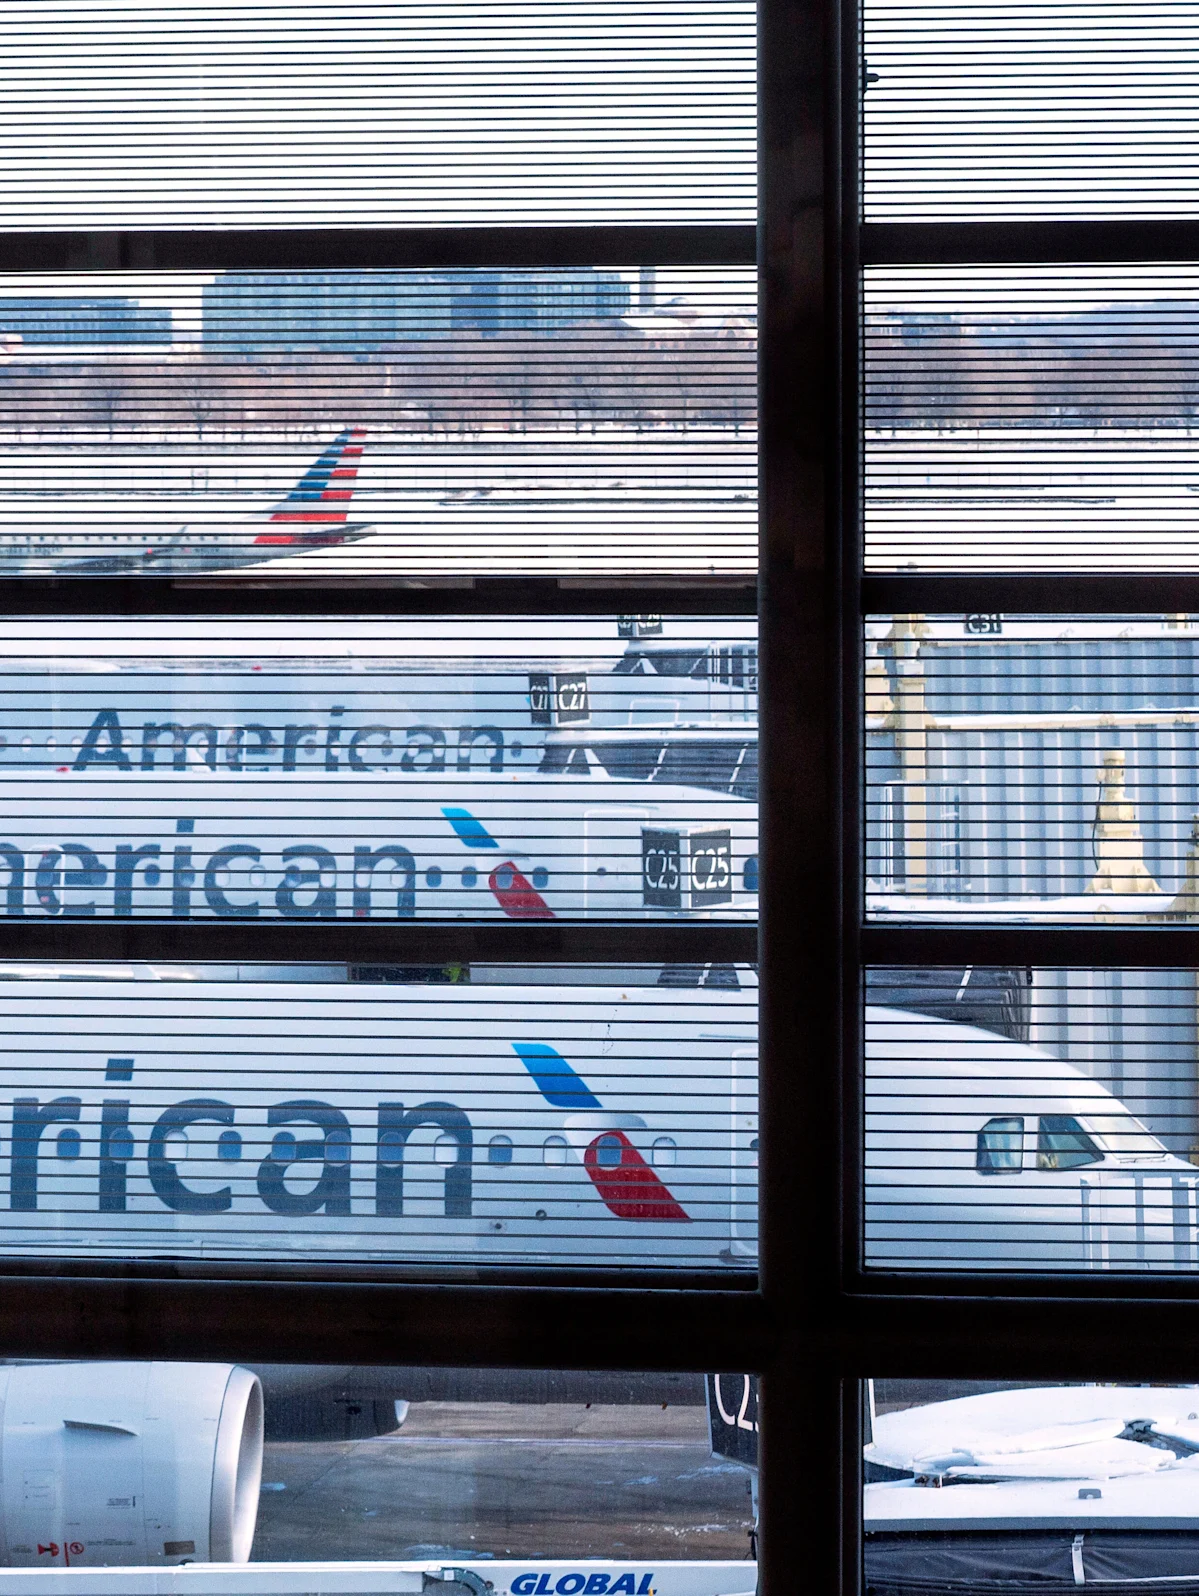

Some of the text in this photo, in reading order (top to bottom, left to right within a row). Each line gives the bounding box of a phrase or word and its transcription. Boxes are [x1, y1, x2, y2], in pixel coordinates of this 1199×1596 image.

[968, 613, 999, 633] C31
[559, 682, 586, 710] C27
[73, 705, 504, 772] American
[645, 848, 679, 890] C25
[692, 847, 729, 890] C25
[714, 1373, 759, 1433] C2
[510, 1573, 658, 1596] GLOBAL
